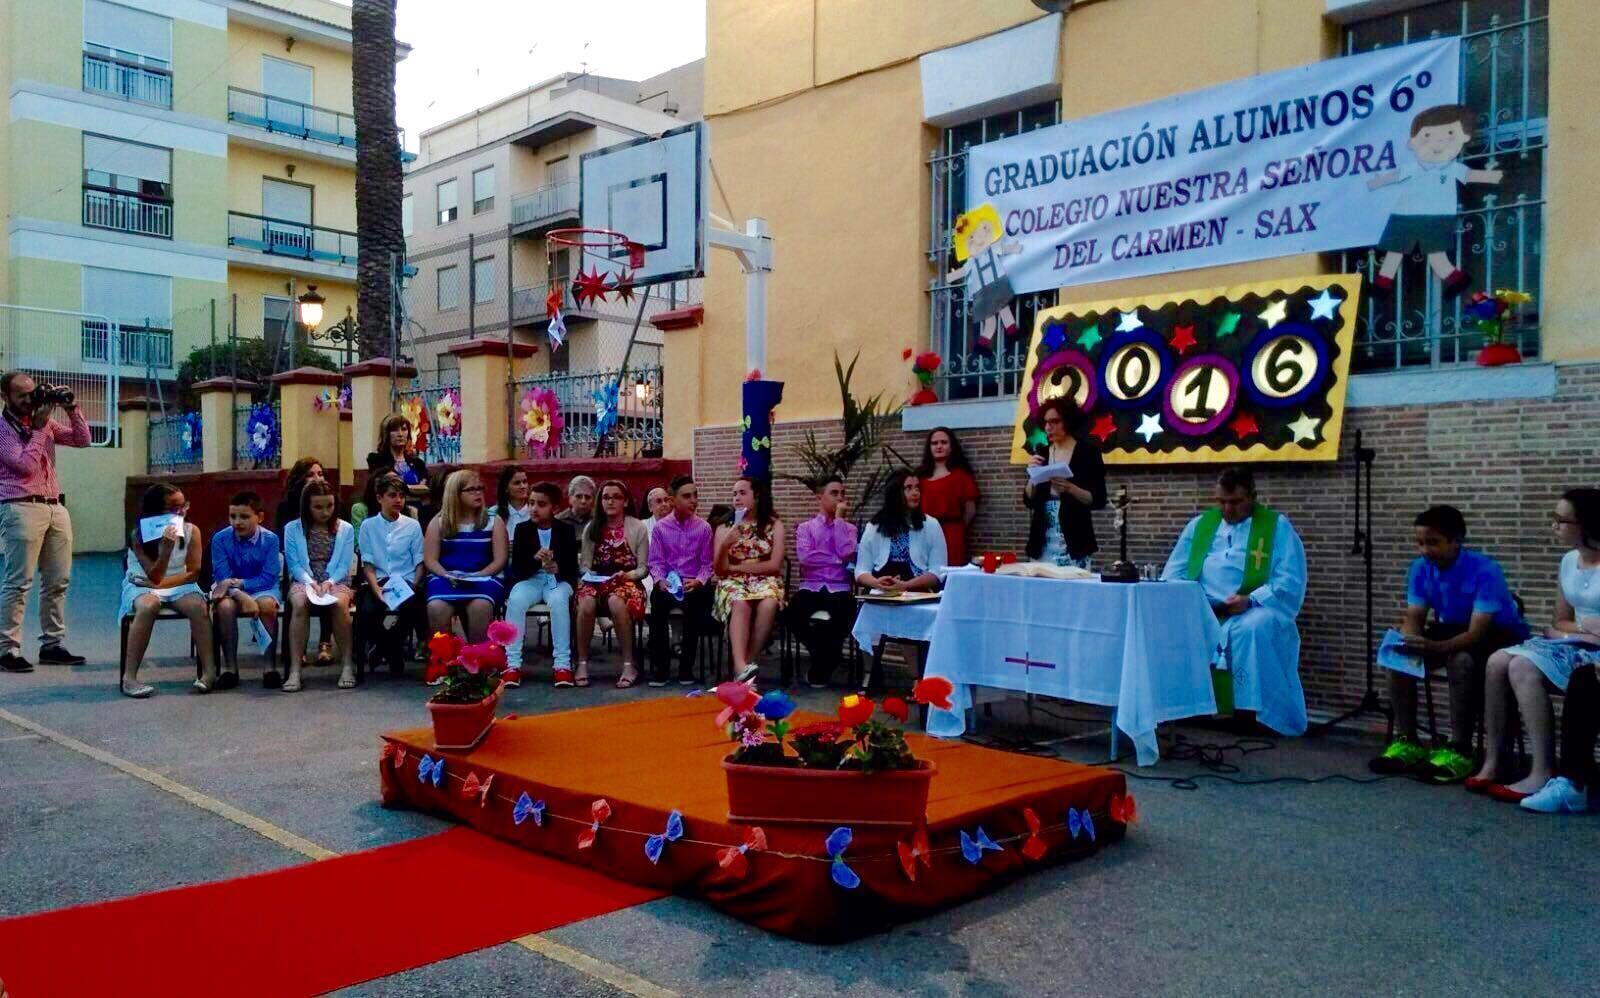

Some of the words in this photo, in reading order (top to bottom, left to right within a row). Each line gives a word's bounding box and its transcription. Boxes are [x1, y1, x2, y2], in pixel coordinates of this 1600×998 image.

[985, 122, 1178, 197] GRADUACIÓN
[1188, 83, 1375, 153] ALUMNOS
[1005, 194, 1109, 237] COLEGIO
[1115, 167, 1248, 217] NUESTRA
[1259, 139, 1397, 192] SEÑORA
[1053, 238, 1102, 270] DEL
[1111, 217, 1228, 262] CARMEN
[1255, 201, 1320, 240] SAX
